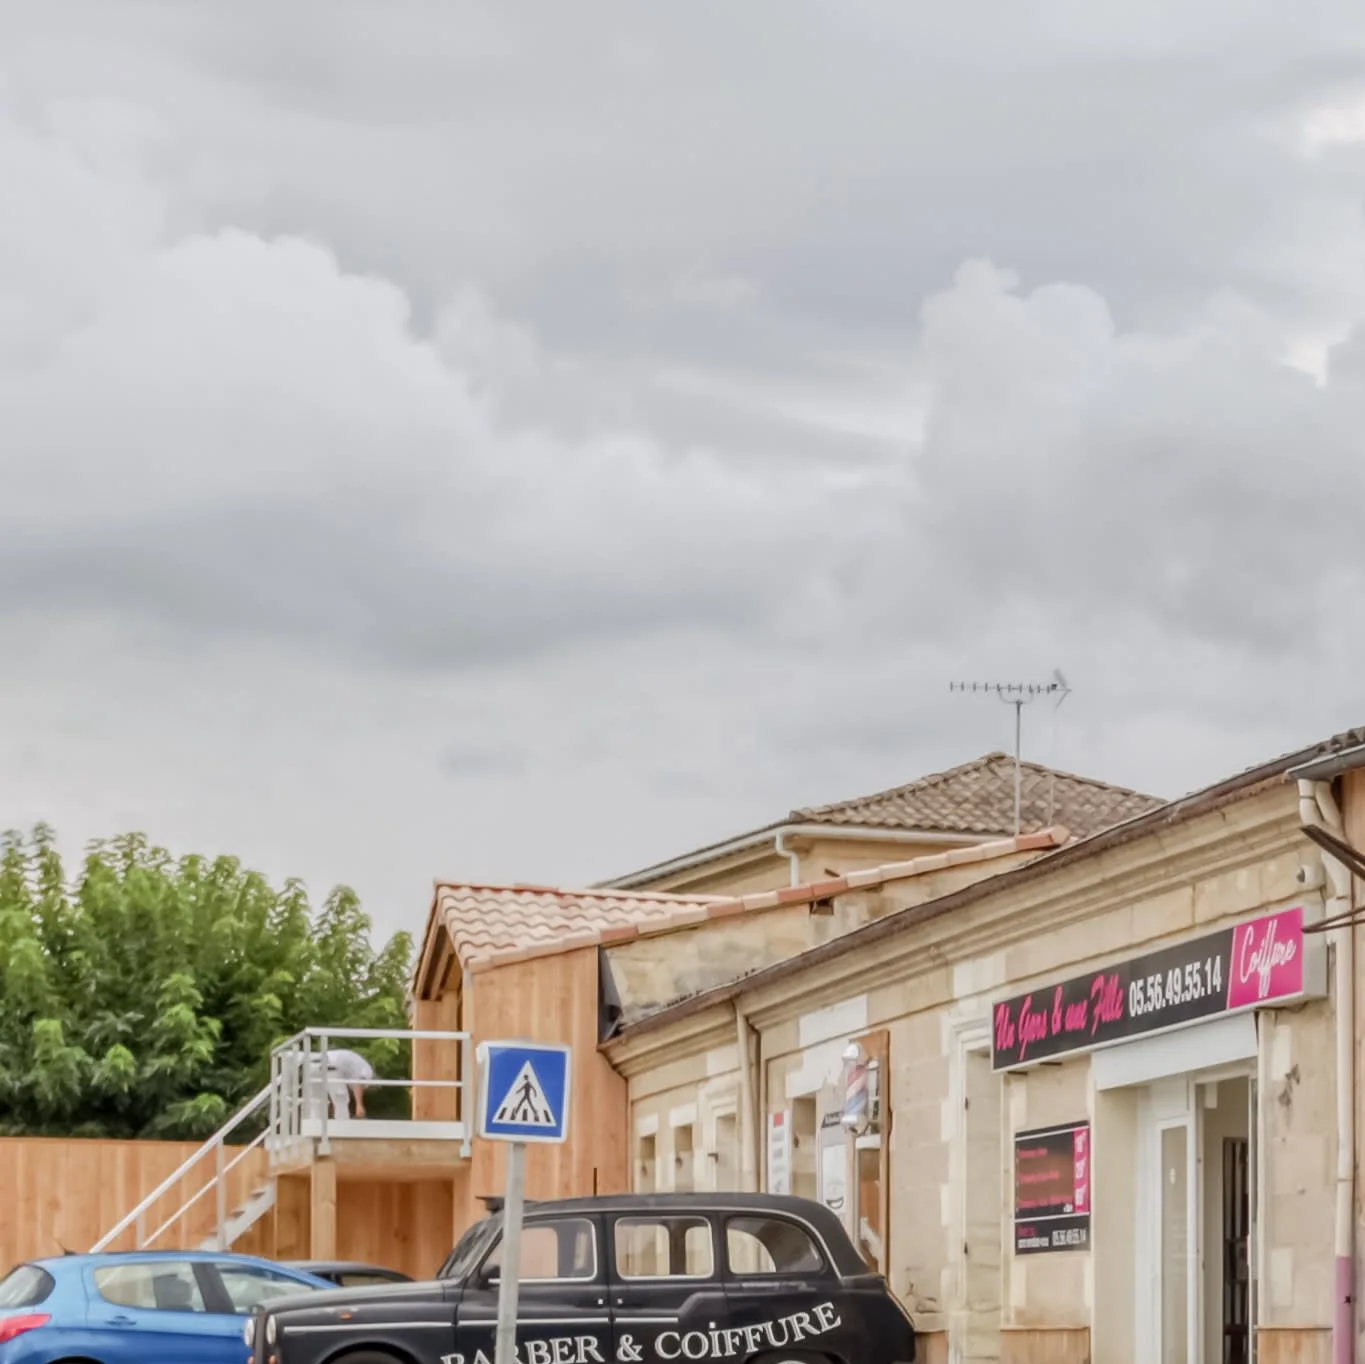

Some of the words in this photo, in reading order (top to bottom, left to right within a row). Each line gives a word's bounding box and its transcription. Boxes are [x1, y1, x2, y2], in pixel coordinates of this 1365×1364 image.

[1129, 955, 1222, 1017] 05.56.49.55.14
[1240, 919, 1297, 999] Coiffure
[616, 1334, 644, 1362] &
